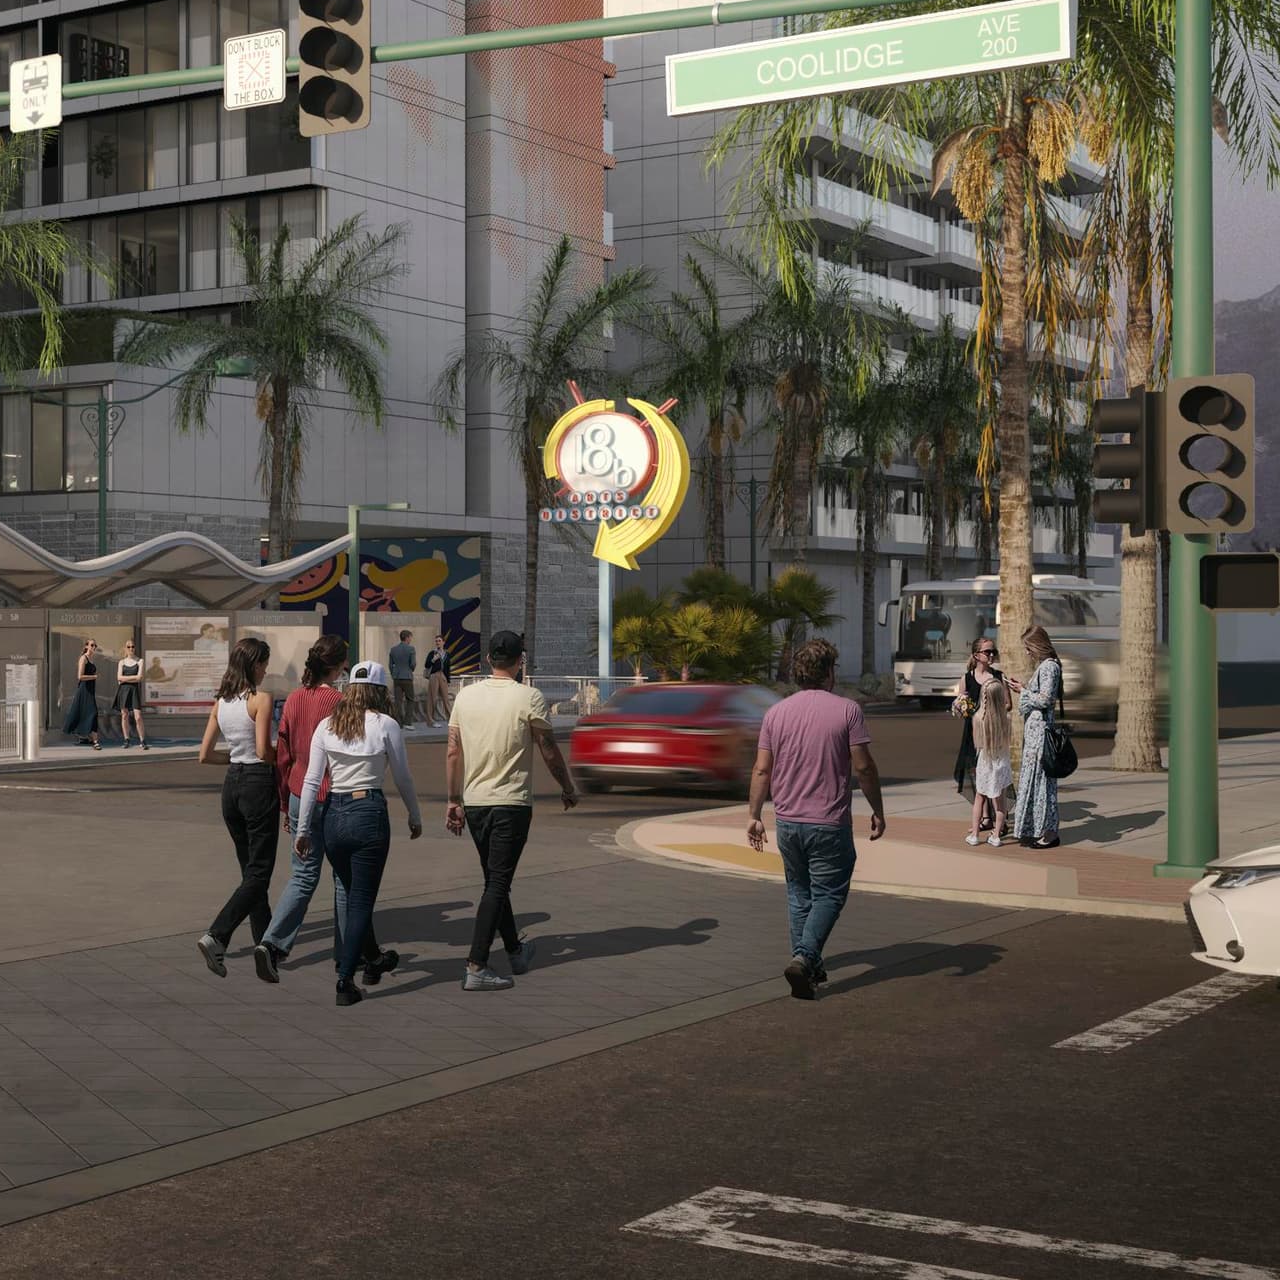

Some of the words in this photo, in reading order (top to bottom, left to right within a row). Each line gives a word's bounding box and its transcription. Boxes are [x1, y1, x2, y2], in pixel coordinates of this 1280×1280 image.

[977, 13, 1021, 38] AVE
[254, 35, 280, 49] BLOCK
[981, 35, 1017, 57] 200
[756, 39, 904, 86] COOLIDGE
[22, 95, 47, 110] ONLY
[234, 90, 251, 104] THE
[254, 87, 274, 102] BOX
[570, 491, 626, 503] ARTS
[541, 506, 657, 521] DISTRICT
